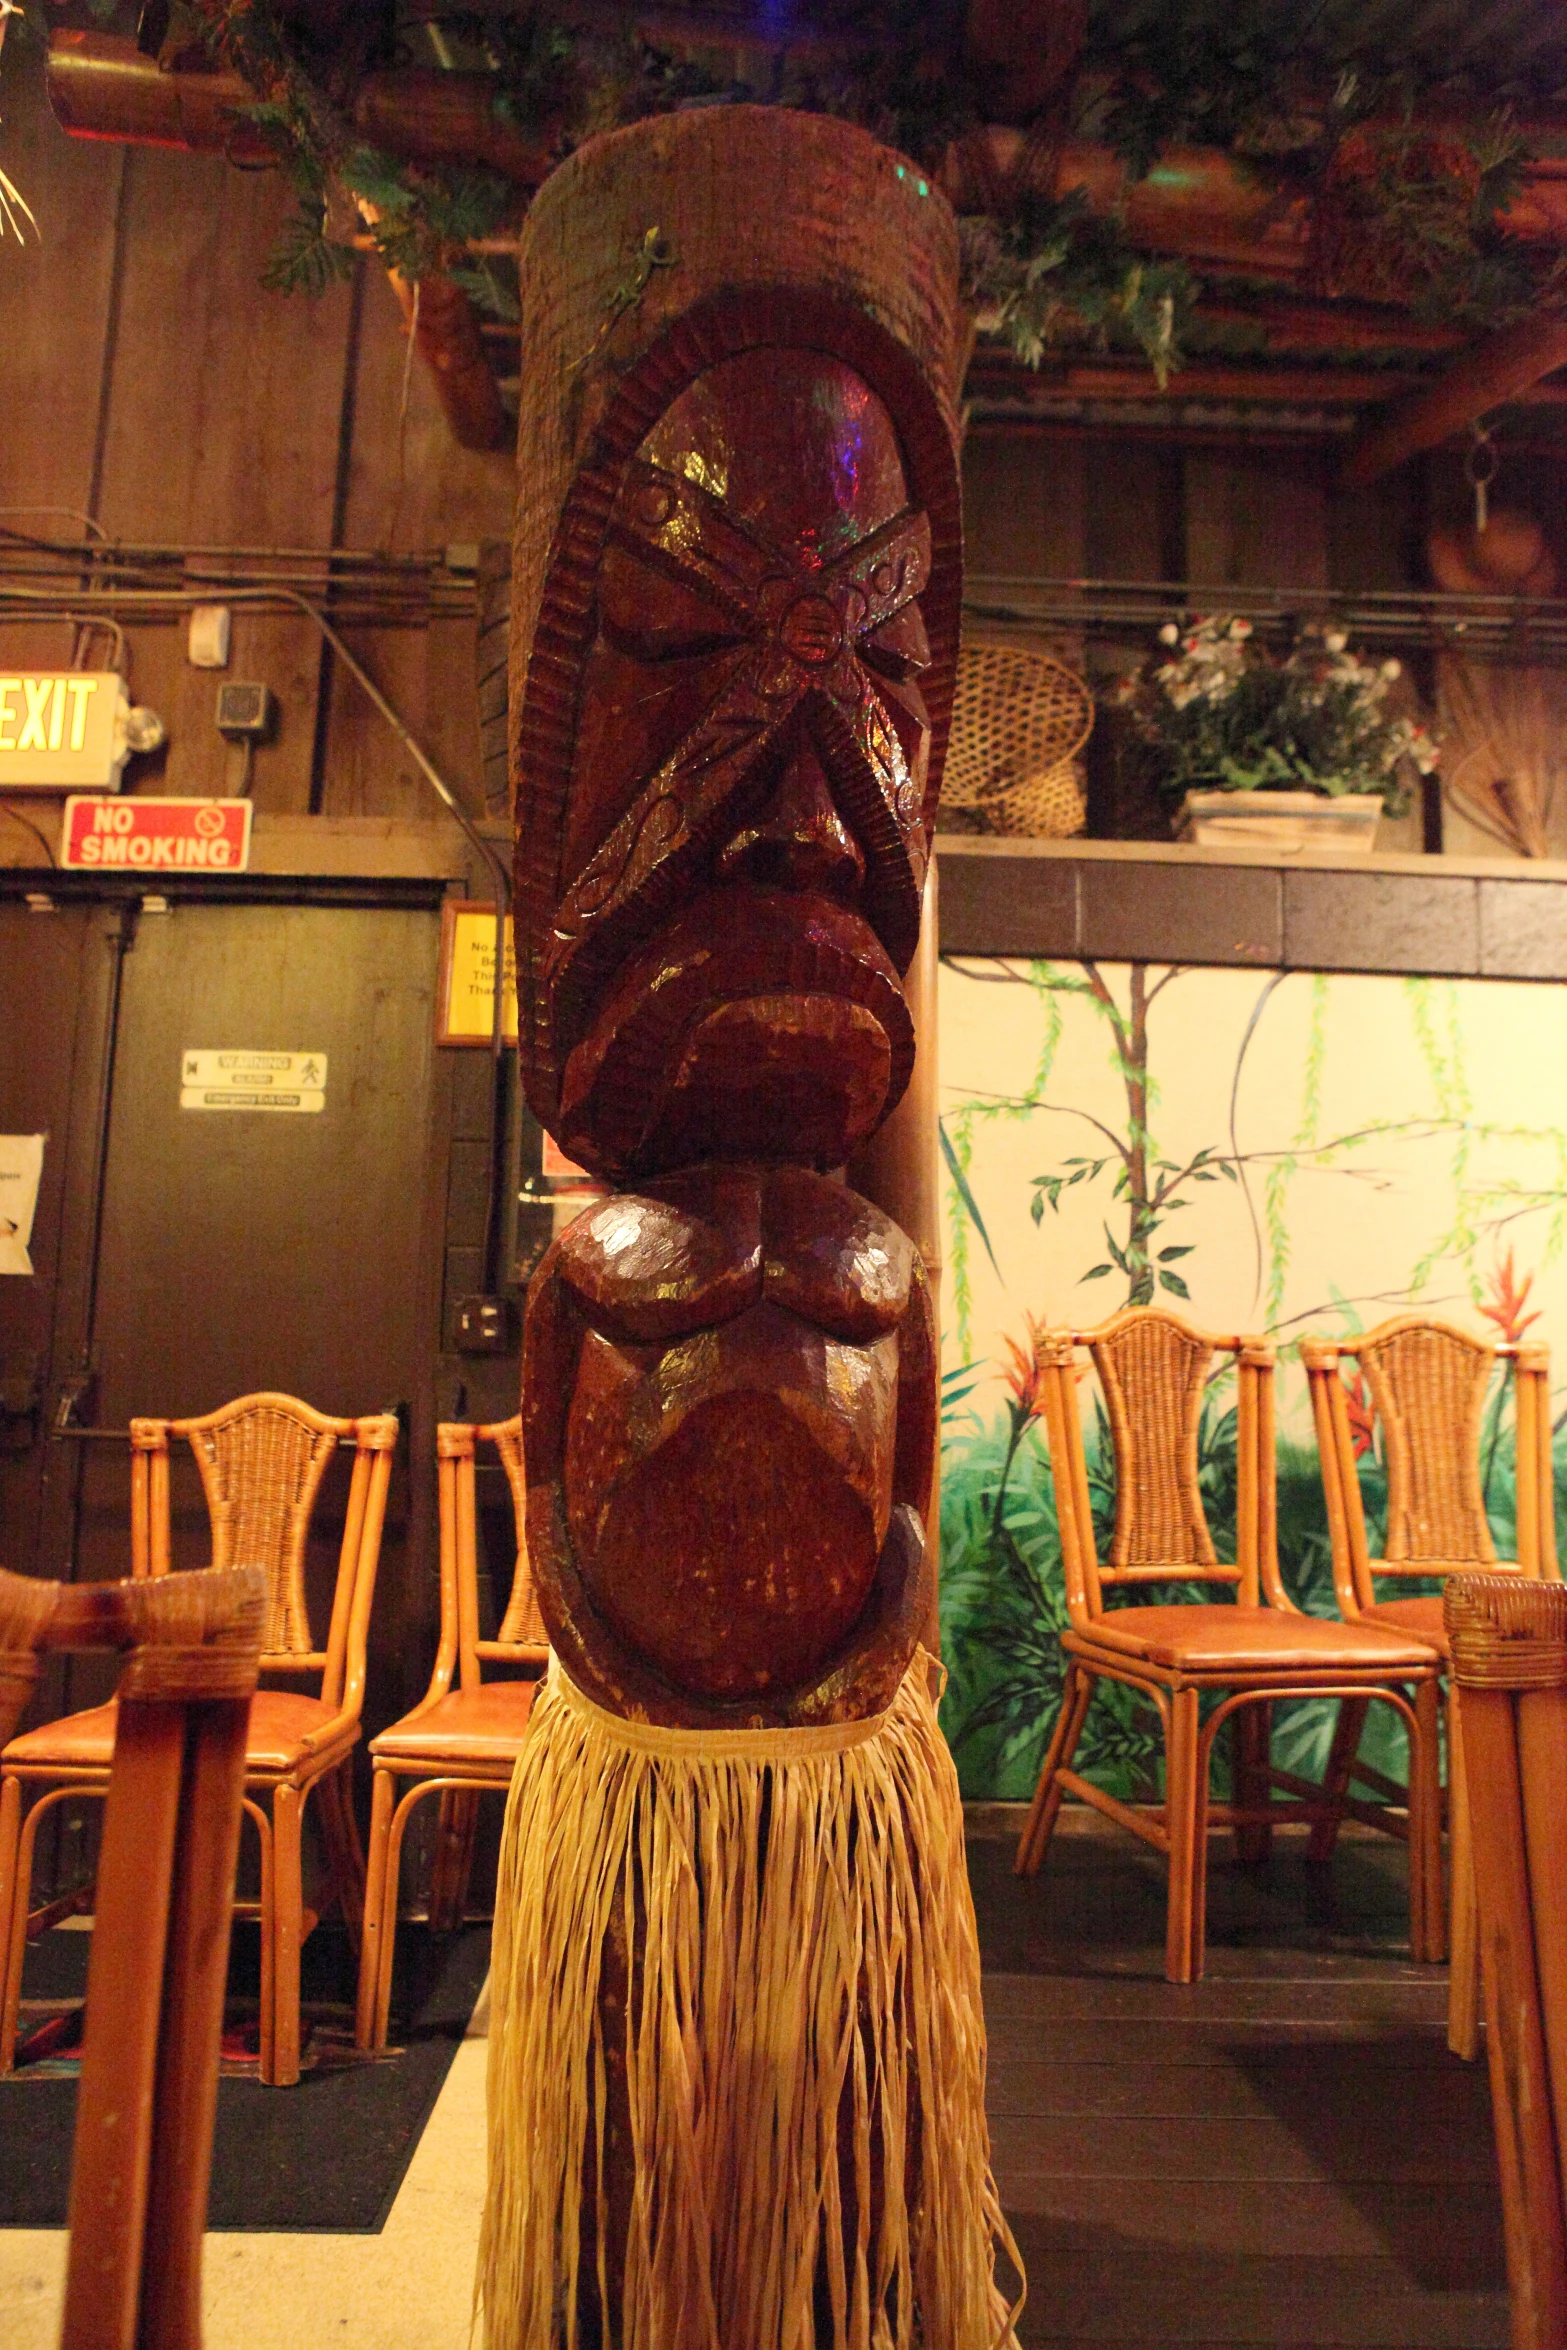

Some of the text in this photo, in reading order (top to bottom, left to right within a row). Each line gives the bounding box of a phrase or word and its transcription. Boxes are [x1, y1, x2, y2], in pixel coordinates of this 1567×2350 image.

[0, 678, 98, 752] EXIT
[94, 807, 134, 833] NO
[81, 836, 230, 866] SMOKING
[471, 942, 488, 951] No
[221, 1056, 289, 1069] WARNING
